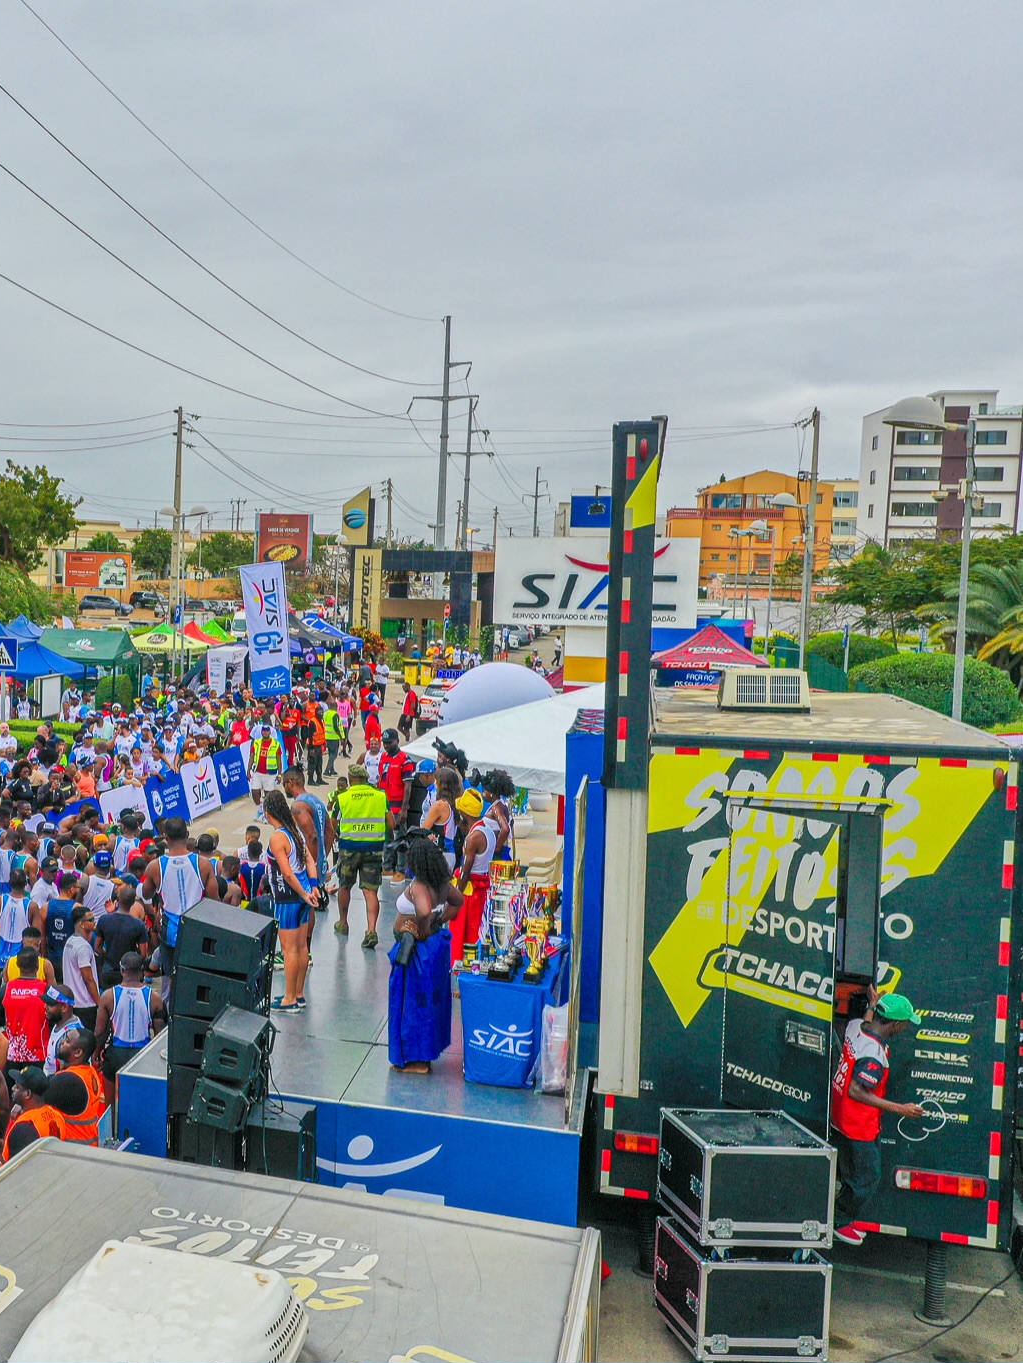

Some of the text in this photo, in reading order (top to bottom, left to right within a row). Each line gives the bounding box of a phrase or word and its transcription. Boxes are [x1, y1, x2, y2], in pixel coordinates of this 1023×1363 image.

[262, 578, 279, 627] SIAC
[512, 612, 540, 621] SERVIÇO
[541, 613, 579, 621] INTEGRADO
[259, 679, 286, 690] SIAC
[192, 779, 214, 805] SIAC
[682, 766, 921, 840] SOMOS
[10, 988, 38, 996] ANPG
[930, 1010, 975, 1021] TCHACO
[922, 1029, 968, 1039] TCHACO
[469, 1029, 533, 1057] SIAC
[911, 1070, 973, 1084] LINKCONNECTION
[915, 1088, 967, 1100] TCHACO
[151, 1207, 346, 1250] DESPORTO
